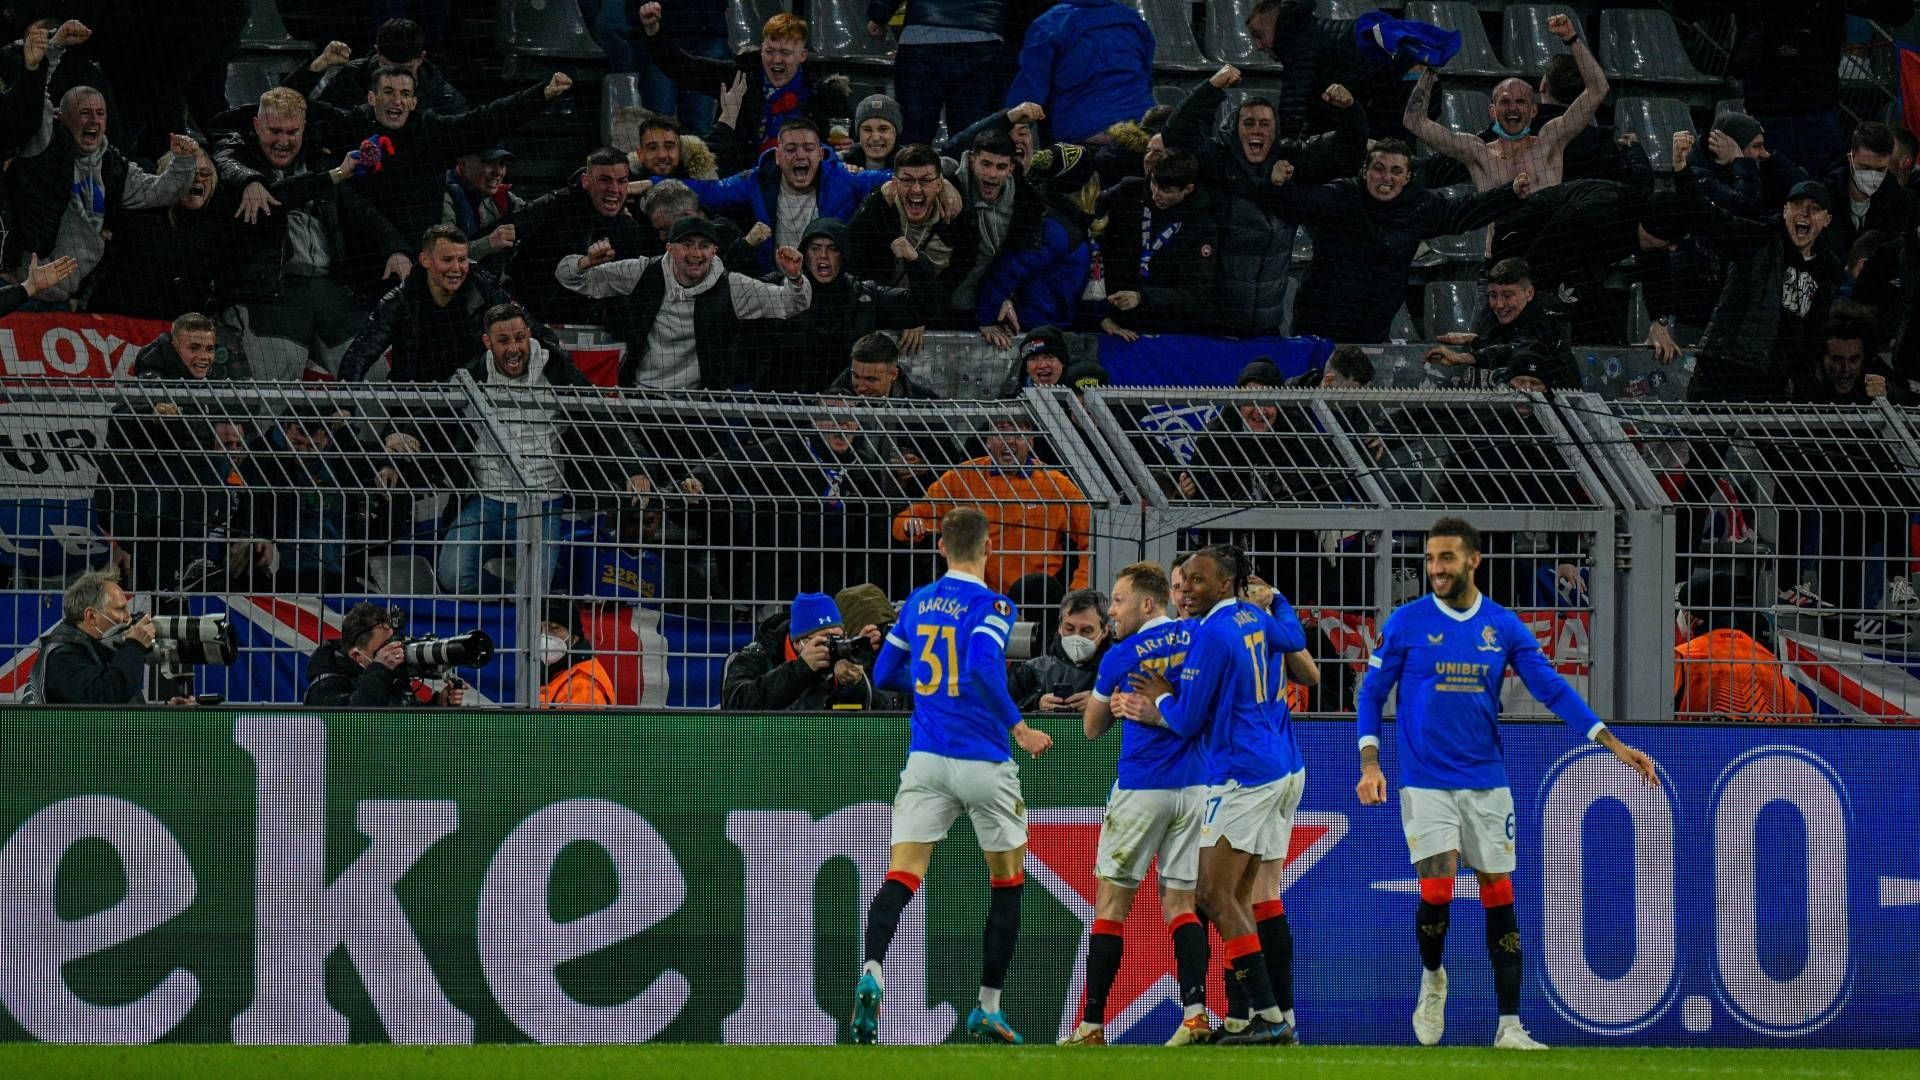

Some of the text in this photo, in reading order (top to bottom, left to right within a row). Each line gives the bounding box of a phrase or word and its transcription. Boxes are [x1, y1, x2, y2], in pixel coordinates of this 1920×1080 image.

[915, 624, 960, 697] 31
[1244, 630, 1267, 704] 17
[1435, 661, 1490, 677] UNIBET
